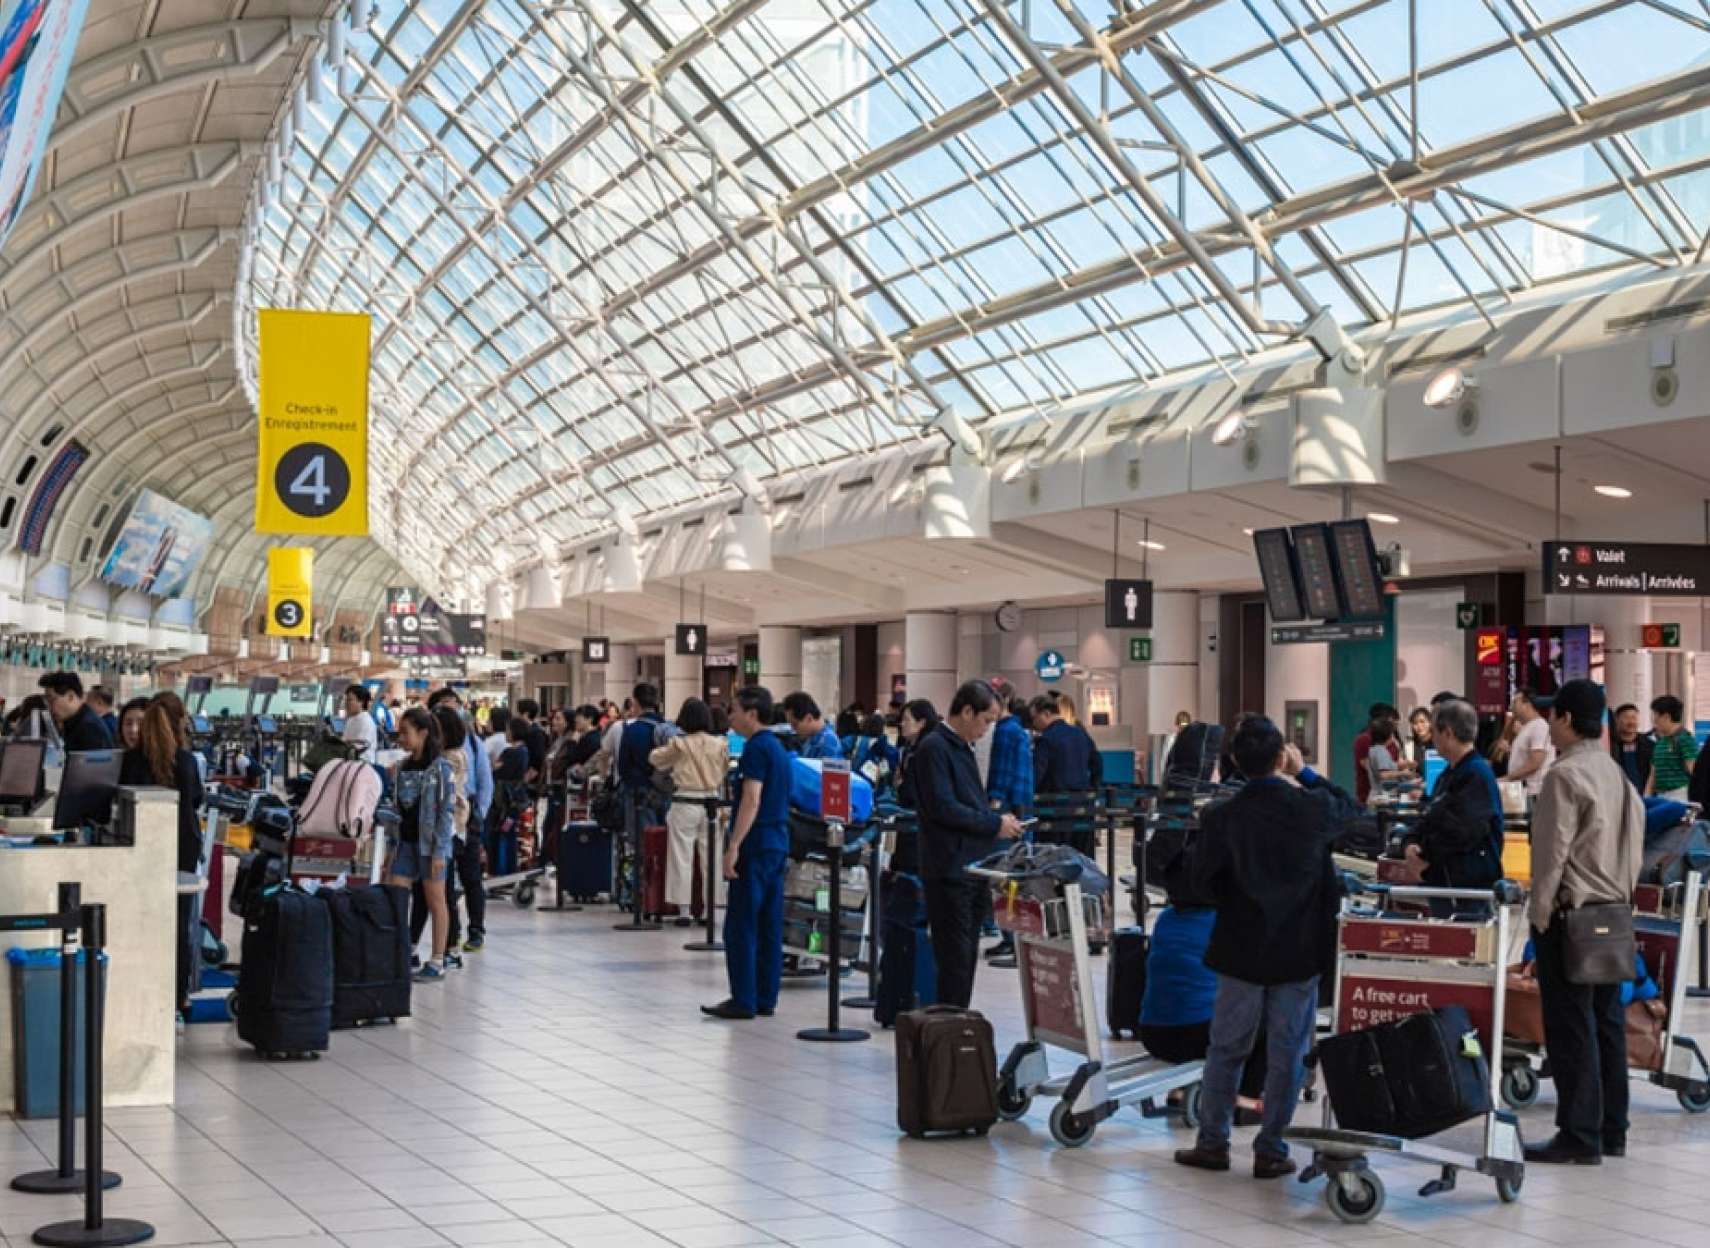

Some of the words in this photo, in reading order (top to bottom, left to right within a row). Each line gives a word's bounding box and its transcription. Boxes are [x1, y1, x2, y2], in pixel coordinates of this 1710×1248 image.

[285, 402, 338, 416] Check-in
[264, 417, 358, 432] Enregistrement
[289, 454, 331, 506] 4
[1596, 550, 1625, 563] Valet
[1596, 573, 1641, 588] Arrivals
[1649, 573, 1696, 589] Arrivées
[281, 603, 297, 626] 3
[1352, 985, 1365, 1001] A
[1367, 986, 1396, 1004] free
[1398, 991, 1429, 1006] cart
[1352, 1006, 1368, 1020] to
[1370, 1008, 1393, 1026] get
